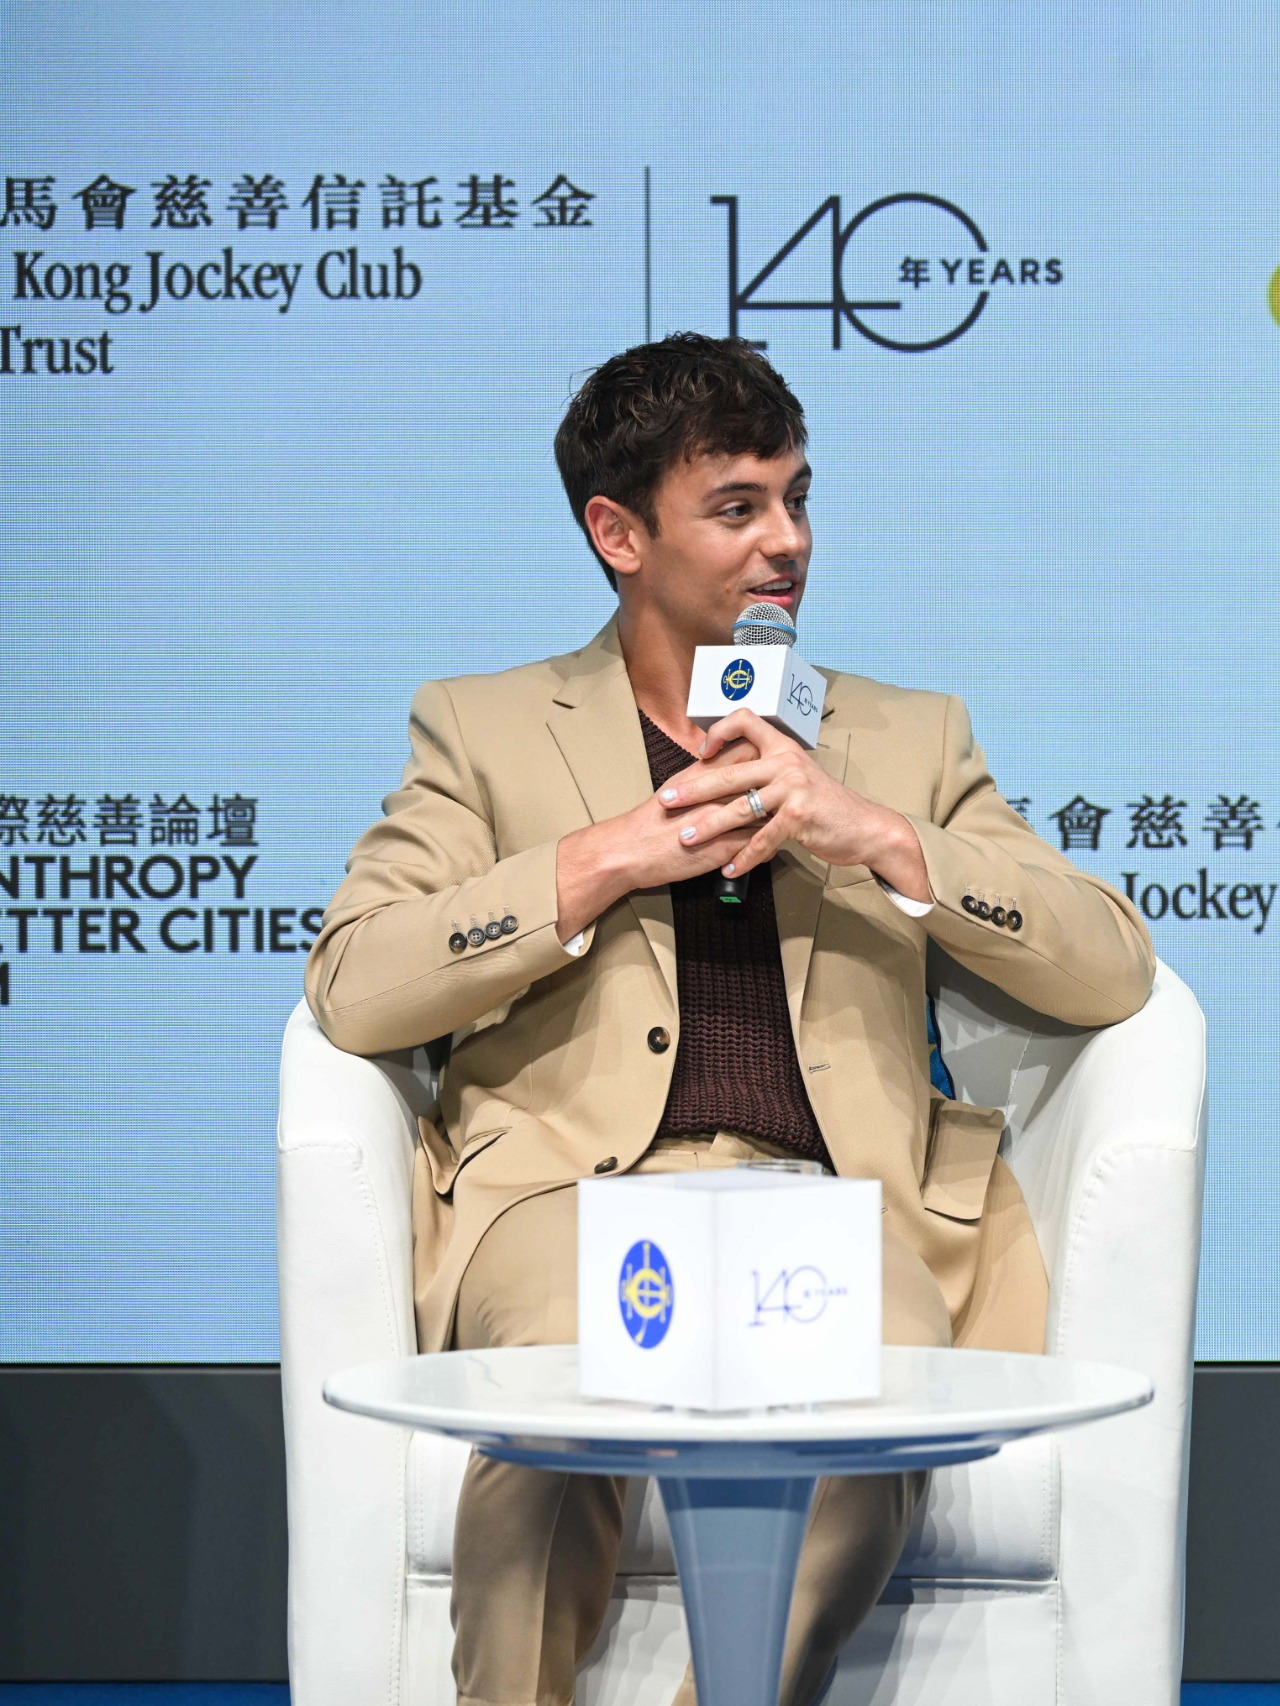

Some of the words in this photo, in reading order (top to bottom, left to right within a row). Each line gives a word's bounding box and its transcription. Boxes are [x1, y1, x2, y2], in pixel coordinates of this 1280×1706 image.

[0, 173, 597, 231] 馬會慈善信託基金
[13, 251, 132, 314] Kong
[138, 246, 302, 314] Jockey
[316, 246, 423, 301] Club
[710, 191, 989, 352] 140
[898, 256, 931, 289] 年
[939, 257, 1064, 286] YEARS
[0, 325, 114, 374] Trust
[0, 908, 147, 953] TTER
[159, 907, 326, 954] CITIES
